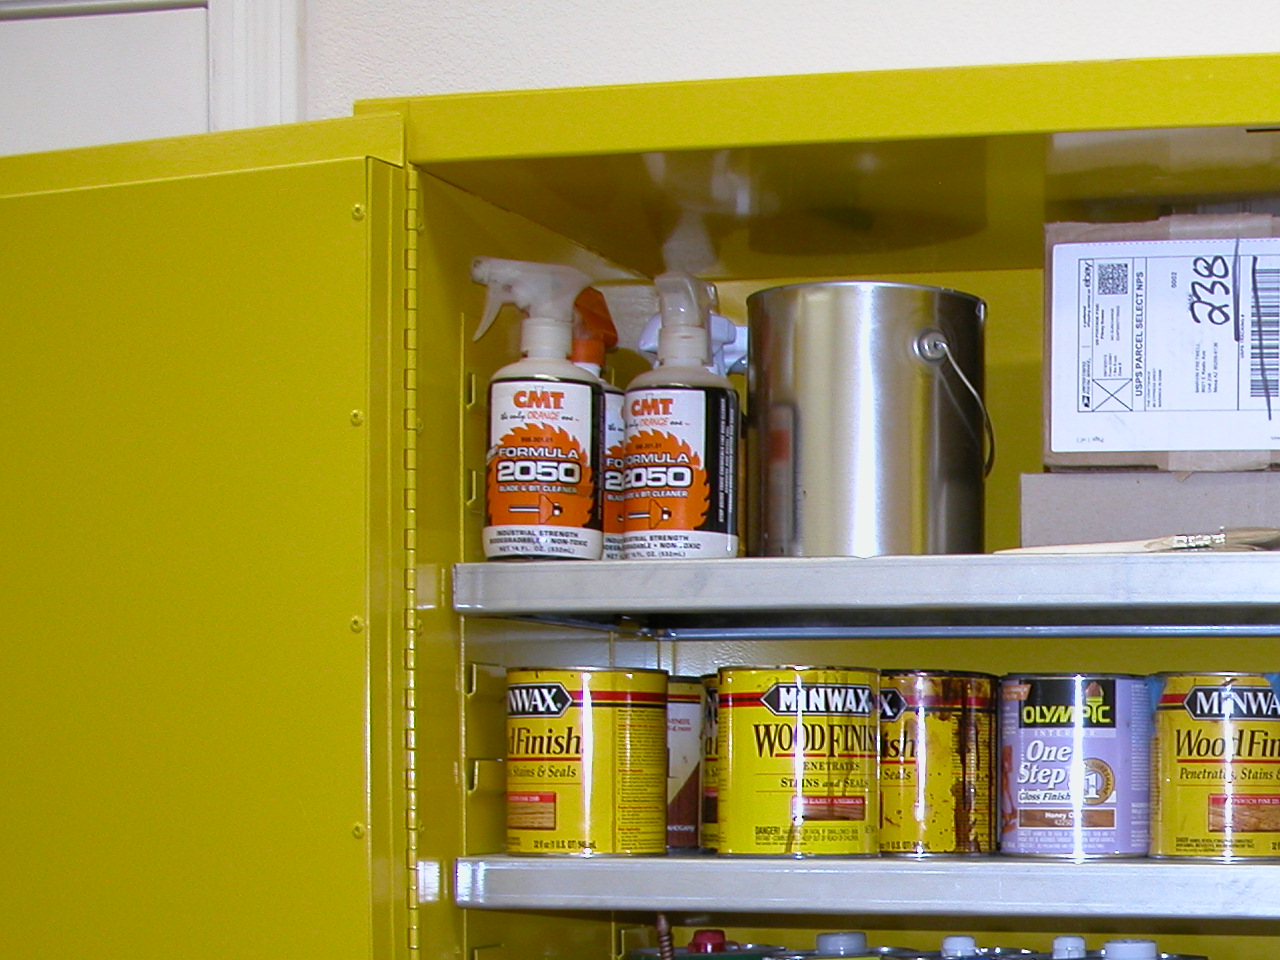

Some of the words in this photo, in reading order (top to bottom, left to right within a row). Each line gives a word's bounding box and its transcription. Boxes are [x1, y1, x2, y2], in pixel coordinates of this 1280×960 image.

[1135, 271, 1144, 291] NPS
[1190, 255, 1231, 326] 238
[1135, 293, 1144, 329] SELECT
[1135, 331, 1144, 369] PARCEL
[1135, 371, 1144, 397] USPS
[513, 390, 564, 409] CMT
[631, 398, 673, 416] CMT
[527, 411, 560, 420] ORANGE
[499, 447, 579, 459] FORMULA
[626, 454, 689, 464] ORMULA
[497, 460, 580, 484] 2050
[622, 466, 691, 488] 2050
[778, 687, 870, 712] MINWAX
[1023, 703, 1112, 724] OLYMPIC
[1027, 739, 1072, 761] One
[1175, 728, 1244, 758] Wood
[548, 765, 577, 778] Seals
[803, 761, 860, 772] ENETRATES
[1017, 762, 1062, 789] Step
[1179, 767, 1237, 781] Penetrats,
[1241, 768, 1275, 780] Stains
[1019, 790, 1040, 802] Gloss
[1042, 790, 1072, 802] Finish
[1045, 812, 1066, 821] Honey
